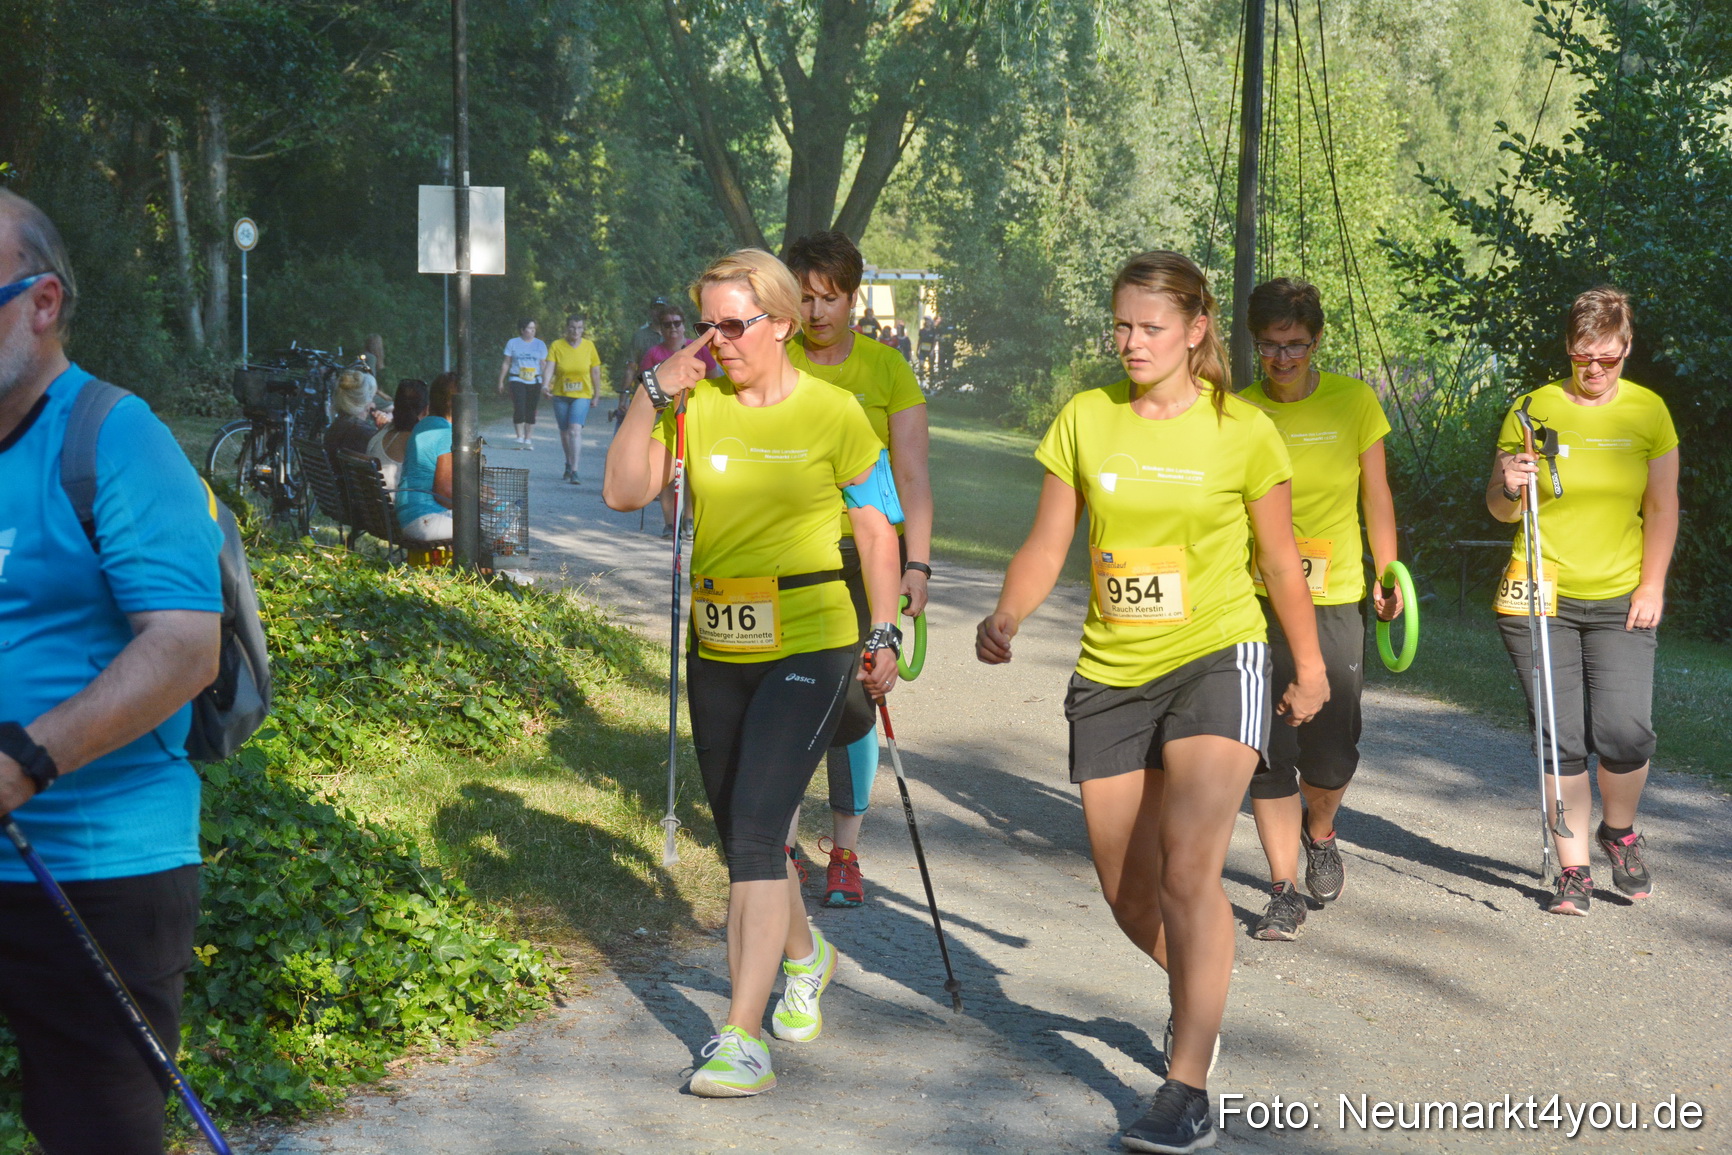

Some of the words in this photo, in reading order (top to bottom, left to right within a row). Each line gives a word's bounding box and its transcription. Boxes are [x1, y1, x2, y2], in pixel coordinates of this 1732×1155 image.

[644, 370, 660, 399] LEKI
[674, 459, 684, 494] LEKI
[1107, 576, 1163, 605] 954
[706, 603, 756, 631] 916
[1112, 605, 1134, 613] Rauch
[1136, 605, 1164, 613] Kerstin
[868, 630, 882, 650] LEKI
